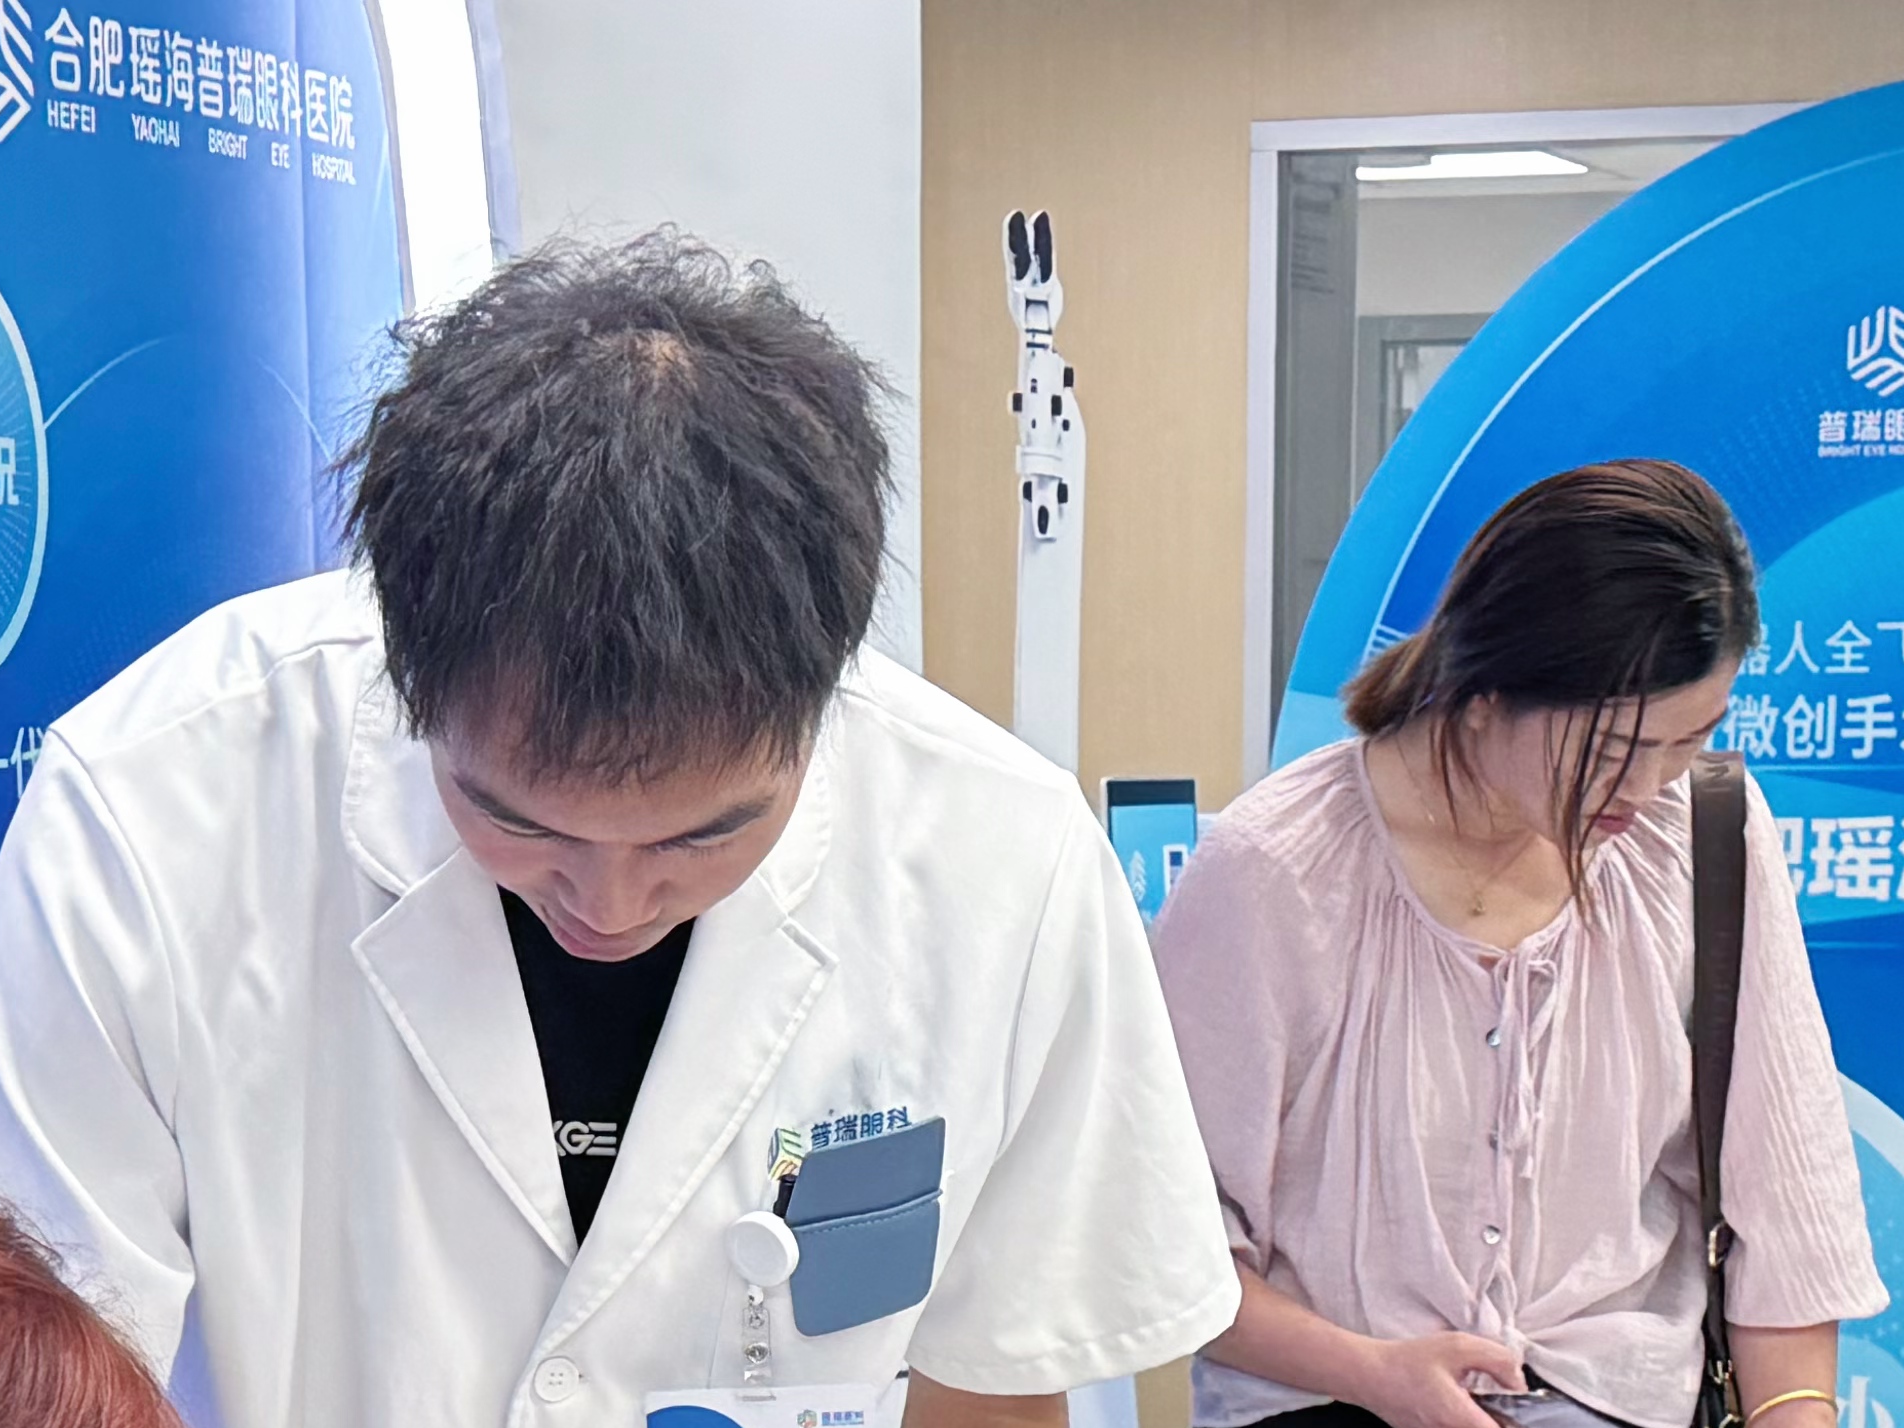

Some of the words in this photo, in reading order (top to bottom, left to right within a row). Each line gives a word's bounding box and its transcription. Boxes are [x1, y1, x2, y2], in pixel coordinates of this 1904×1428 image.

[44, 7, 357, 150] 合肥瑶海普瑞眼科医院
[47, 100, 96, 134] HEFEI
[131, 113, 181, 149] YAOHAI
[207, 127, 248, 162] BRIGHT
[270, 141, 292, 170] EYE
[810, 1105, 913, 1148] 普瑞眼科
